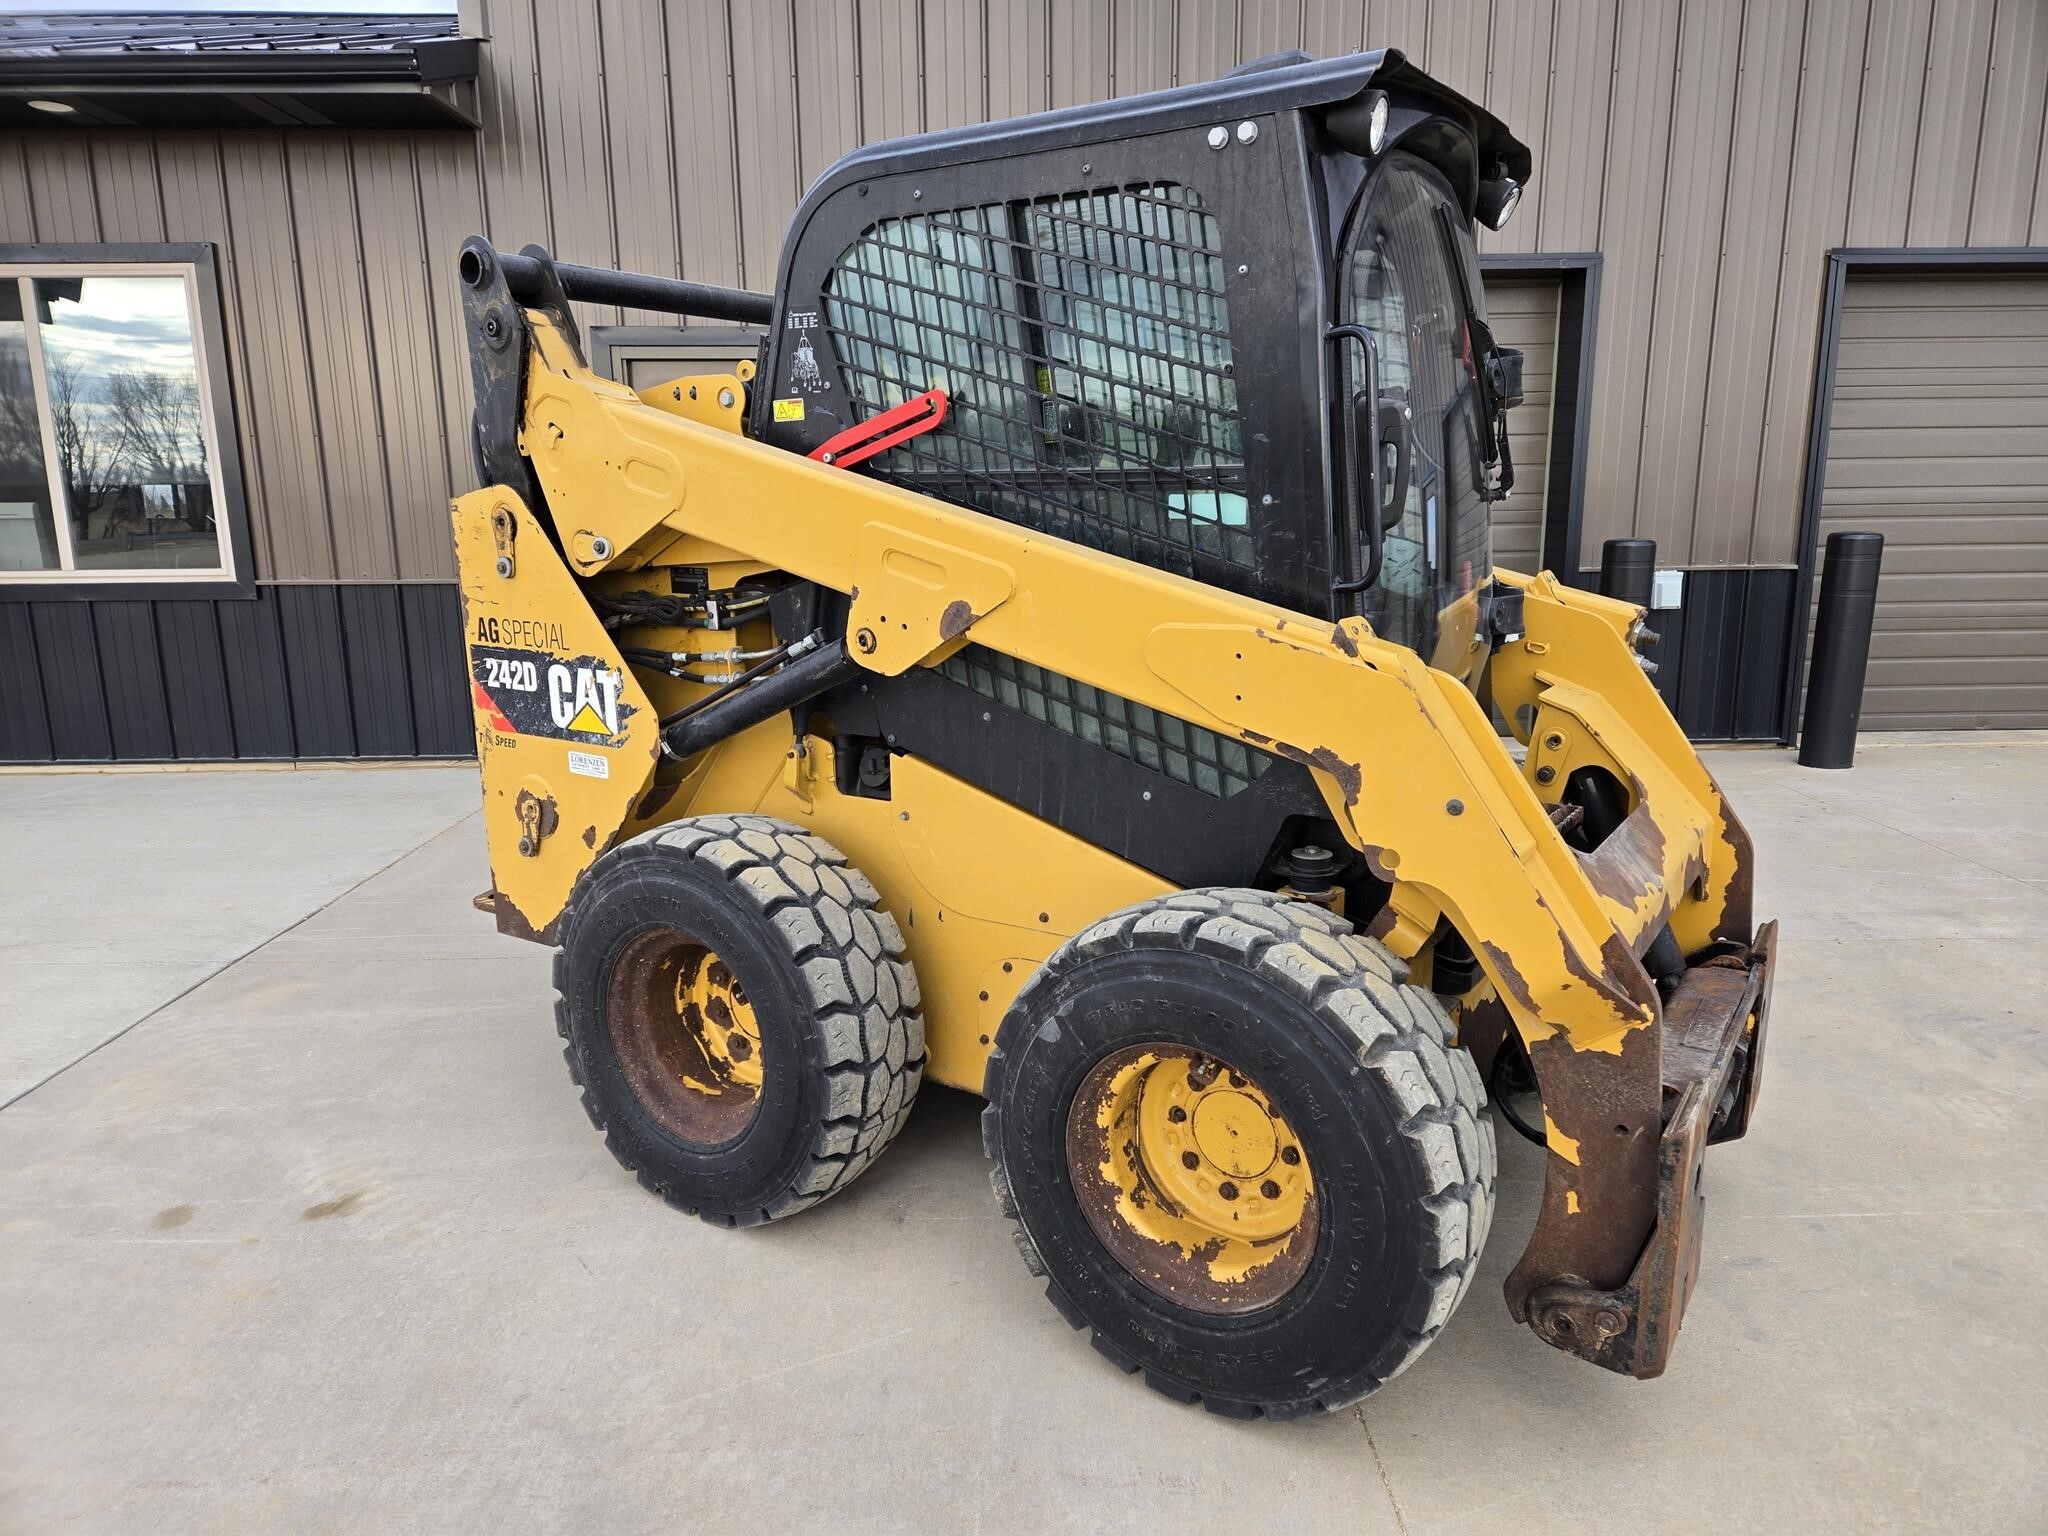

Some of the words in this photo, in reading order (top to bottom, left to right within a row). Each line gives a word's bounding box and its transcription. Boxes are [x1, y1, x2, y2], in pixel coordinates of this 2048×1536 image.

[478, 617, 500, 643] AG
[502, 618, 570, 651] SPECIAL
[486, 658, 538, 692] 242D
[547, 664, 622, 736] CAT
[495, 734, 517, 749] SPEED
